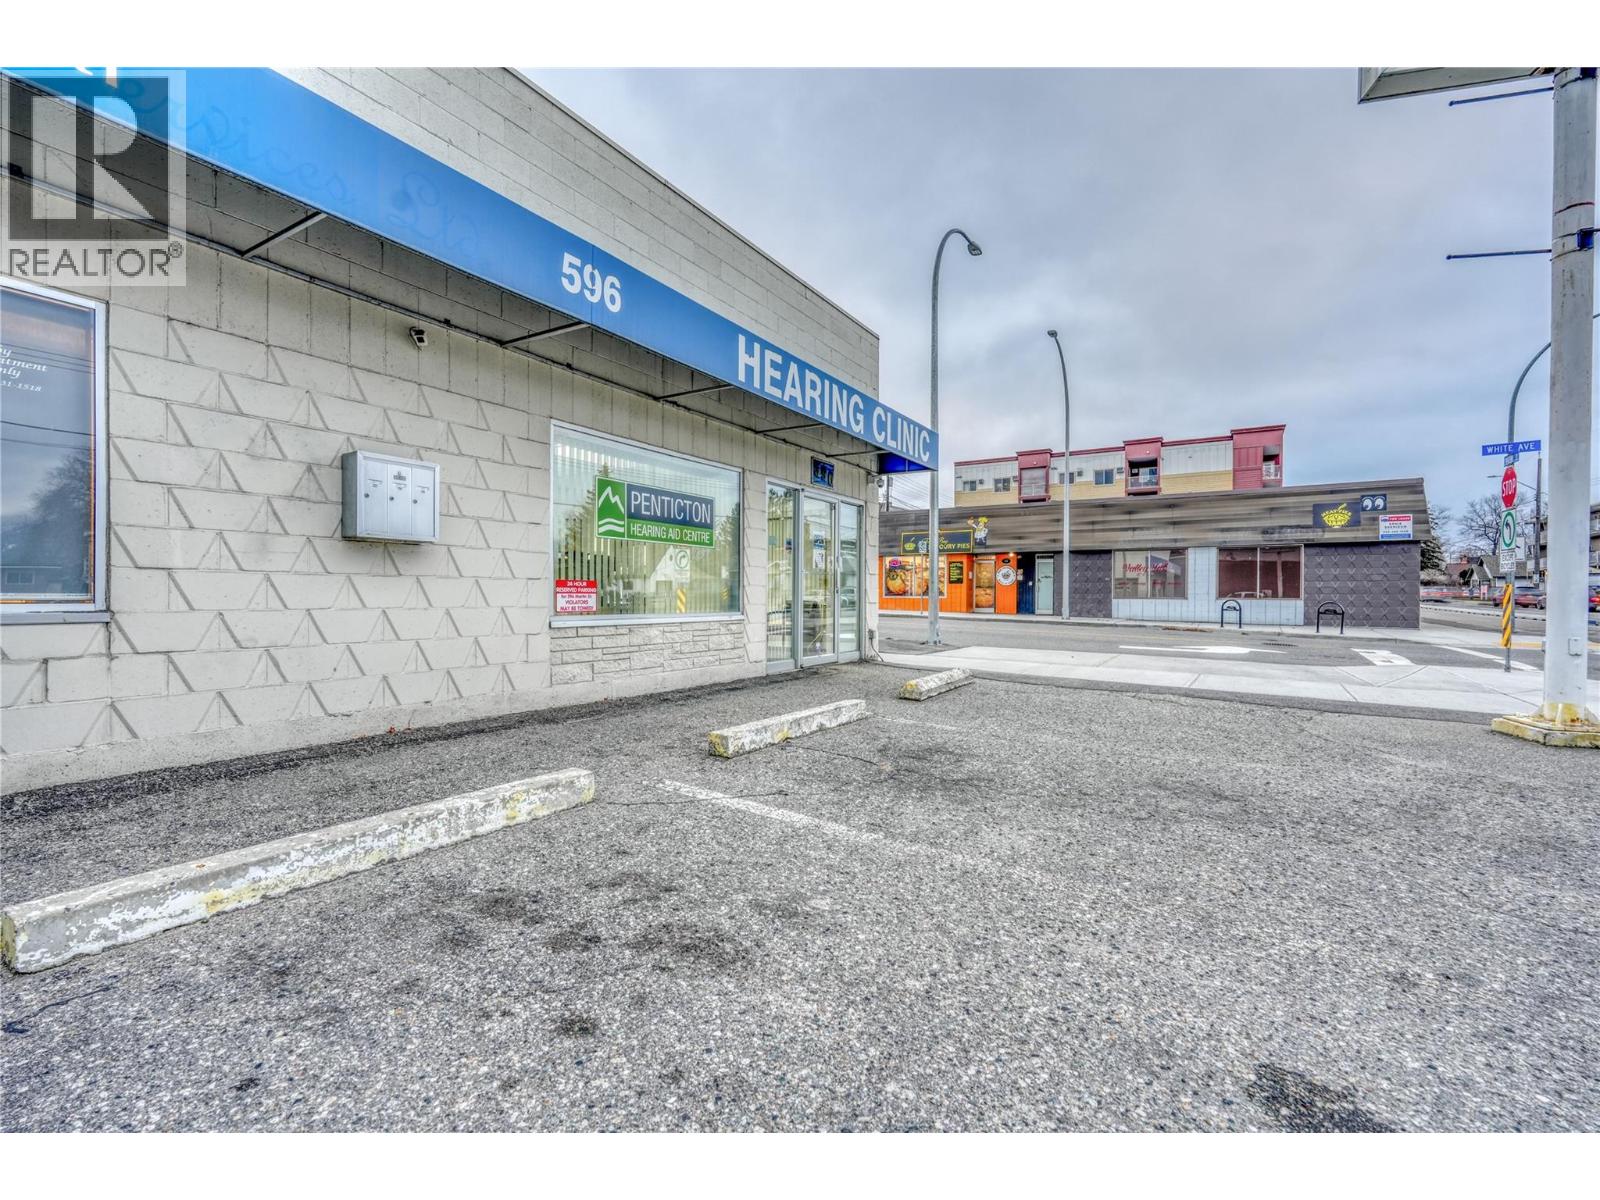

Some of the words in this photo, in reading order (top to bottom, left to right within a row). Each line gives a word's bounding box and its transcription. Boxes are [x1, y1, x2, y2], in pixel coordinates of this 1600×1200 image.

[561, 251, 622, 313] 596
[738, 334, 865, 435] HEARING
[872, 406, 930, 463] CLINIC
[1487, 444, 1514, 454] WHITE
[1518, 442, 1535, 451] AVE
[1502, 477, 1516, 497] STOP
[631, 490, 711, 524] PENTICTON
[630, 523, 667, 539] HEARING
[668, 528, 681, 541] AID
[683, 530, 710, 544] CENTRE
